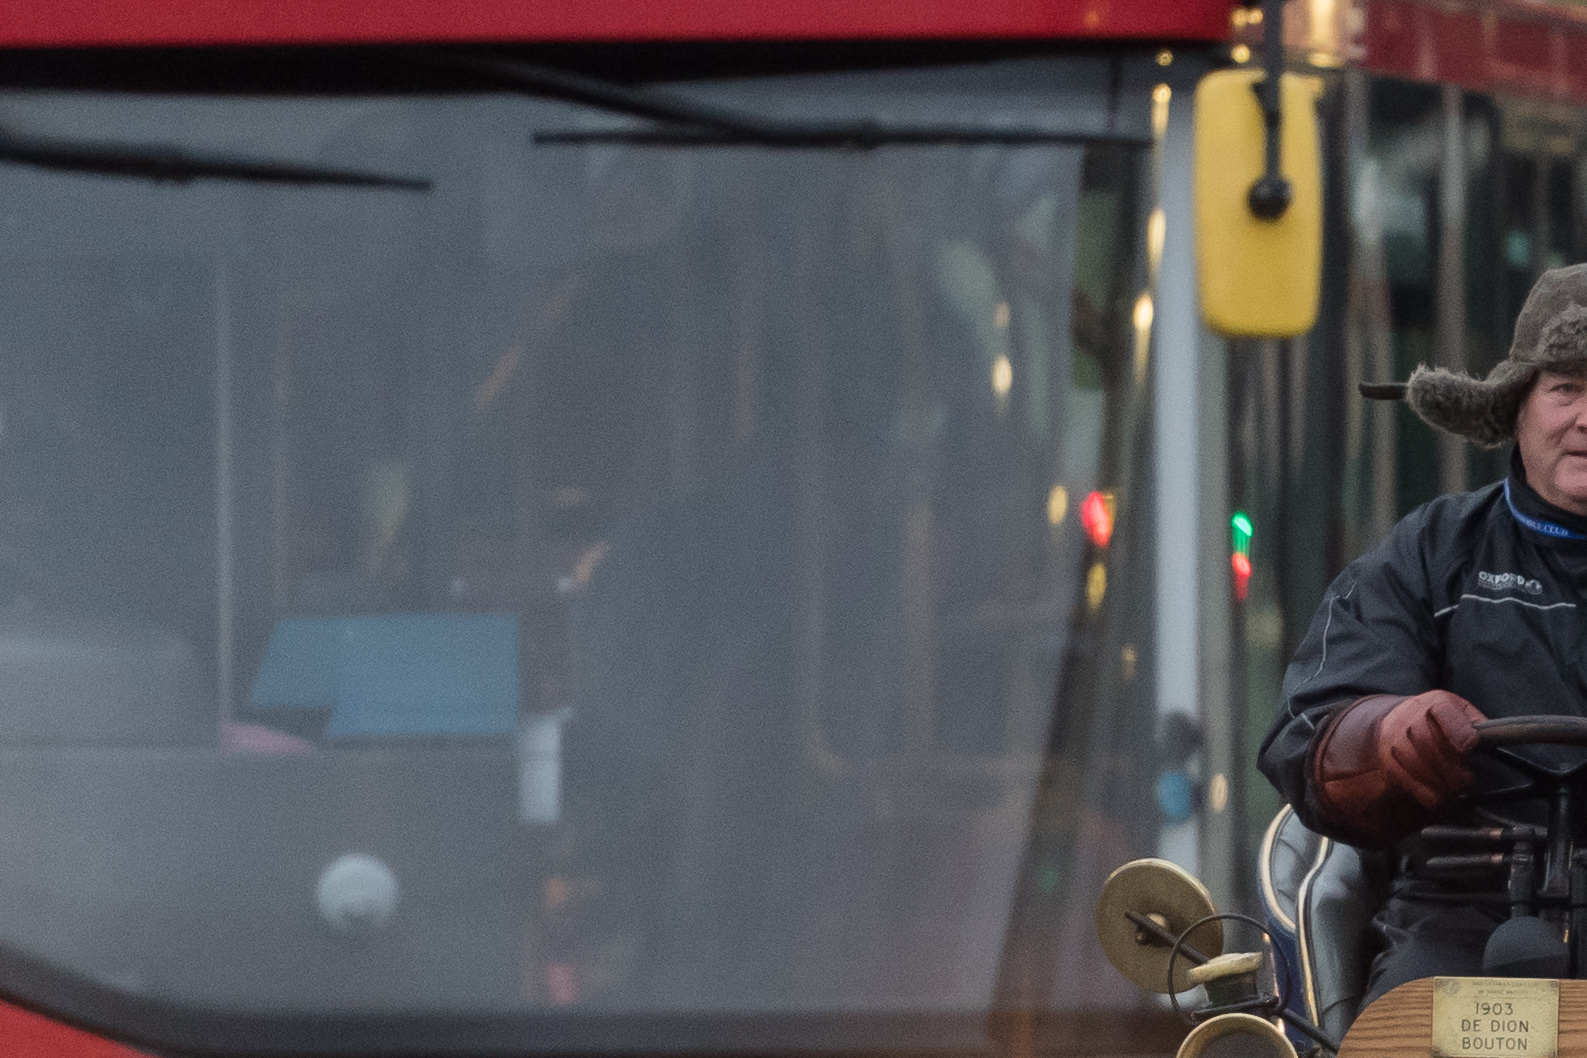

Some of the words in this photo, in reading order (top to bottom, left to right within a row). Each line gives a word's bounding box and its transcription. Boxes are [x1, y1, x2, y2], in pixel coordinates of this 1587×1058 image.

[1475, 1002, 1514, 1016] 1903
[1460, 1019, 1482, 1032] DE
[1490, 1020, 1530, 1033] DION
[1461, 1036, 1529, 1051] BOUTON
